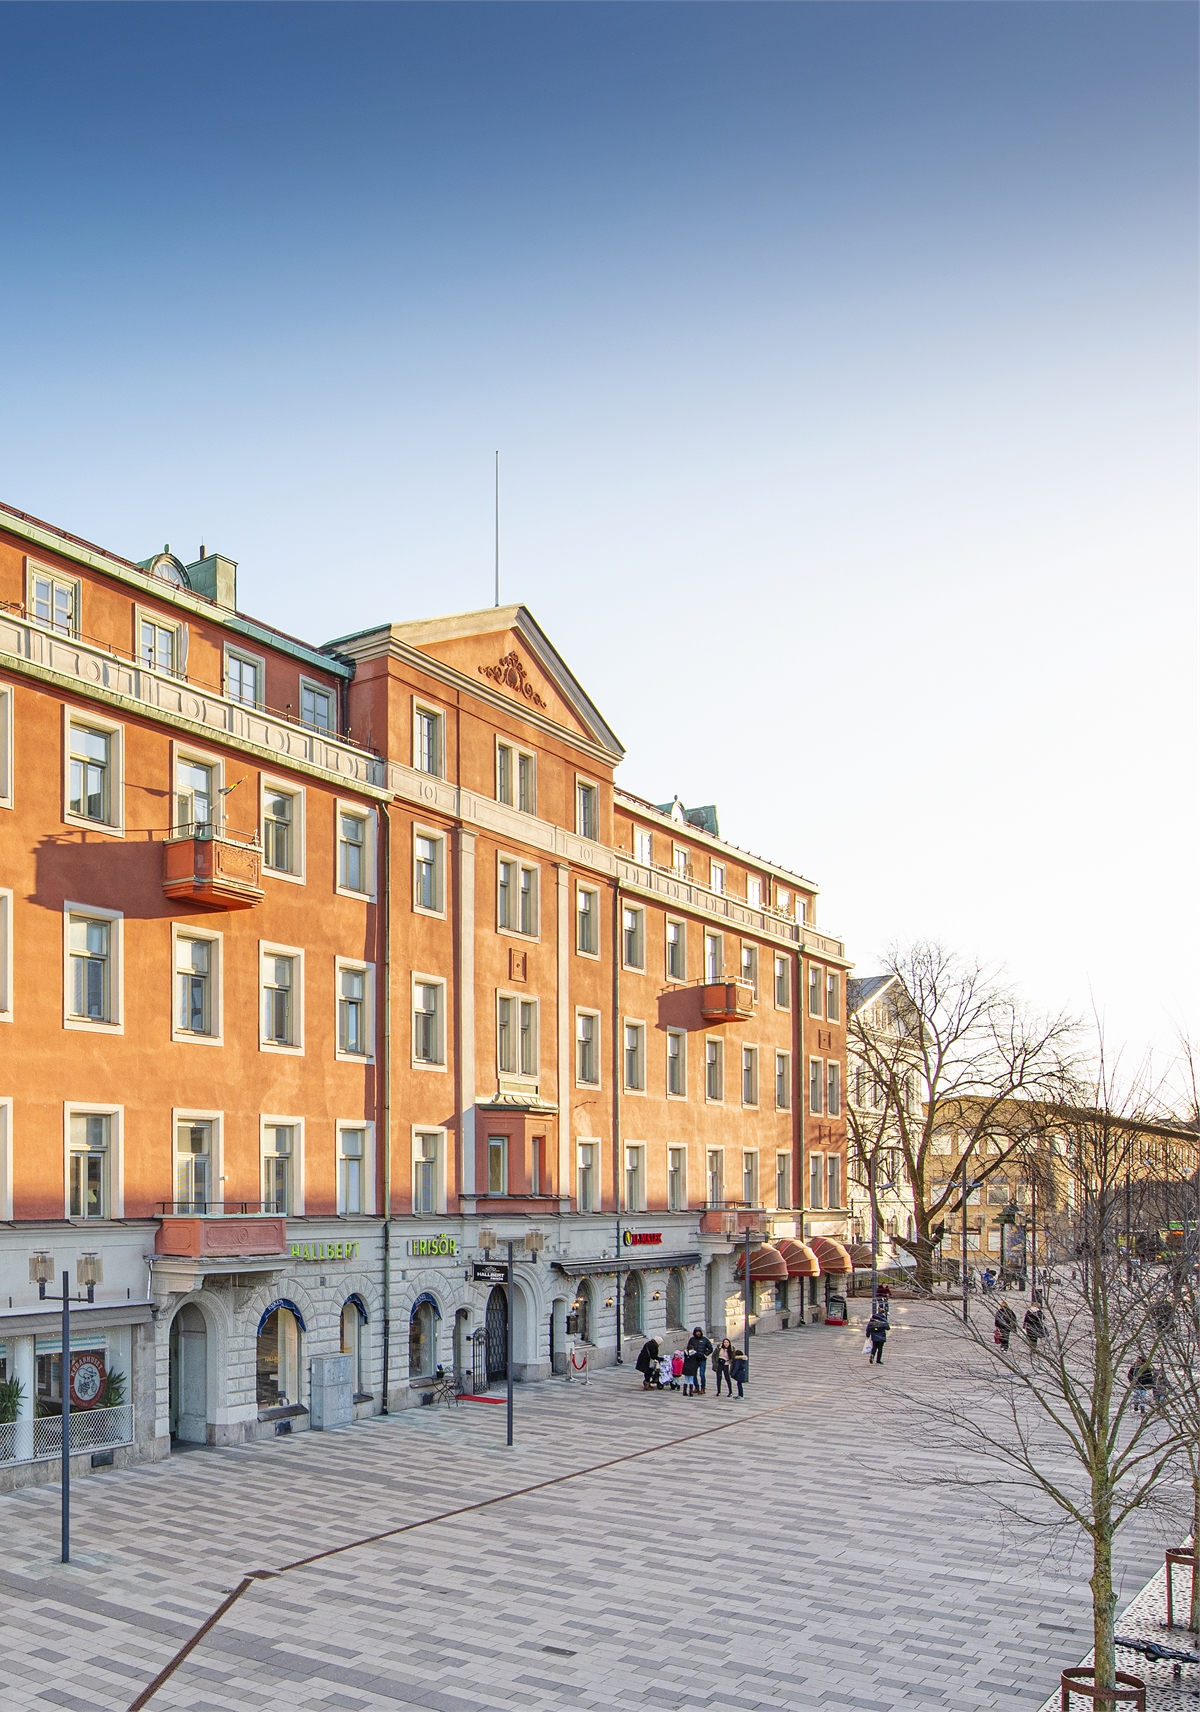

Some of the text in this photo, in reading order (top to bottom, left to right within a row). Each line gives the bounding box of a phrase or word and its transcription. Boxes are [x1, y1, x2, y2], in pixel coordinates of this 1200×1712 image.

[292, 1241, 360, 1261] HALLBERT
[413, 1233, 458, 1256] FRISÖR
[71, 1355, 104, 1377] KEBABHUSET
